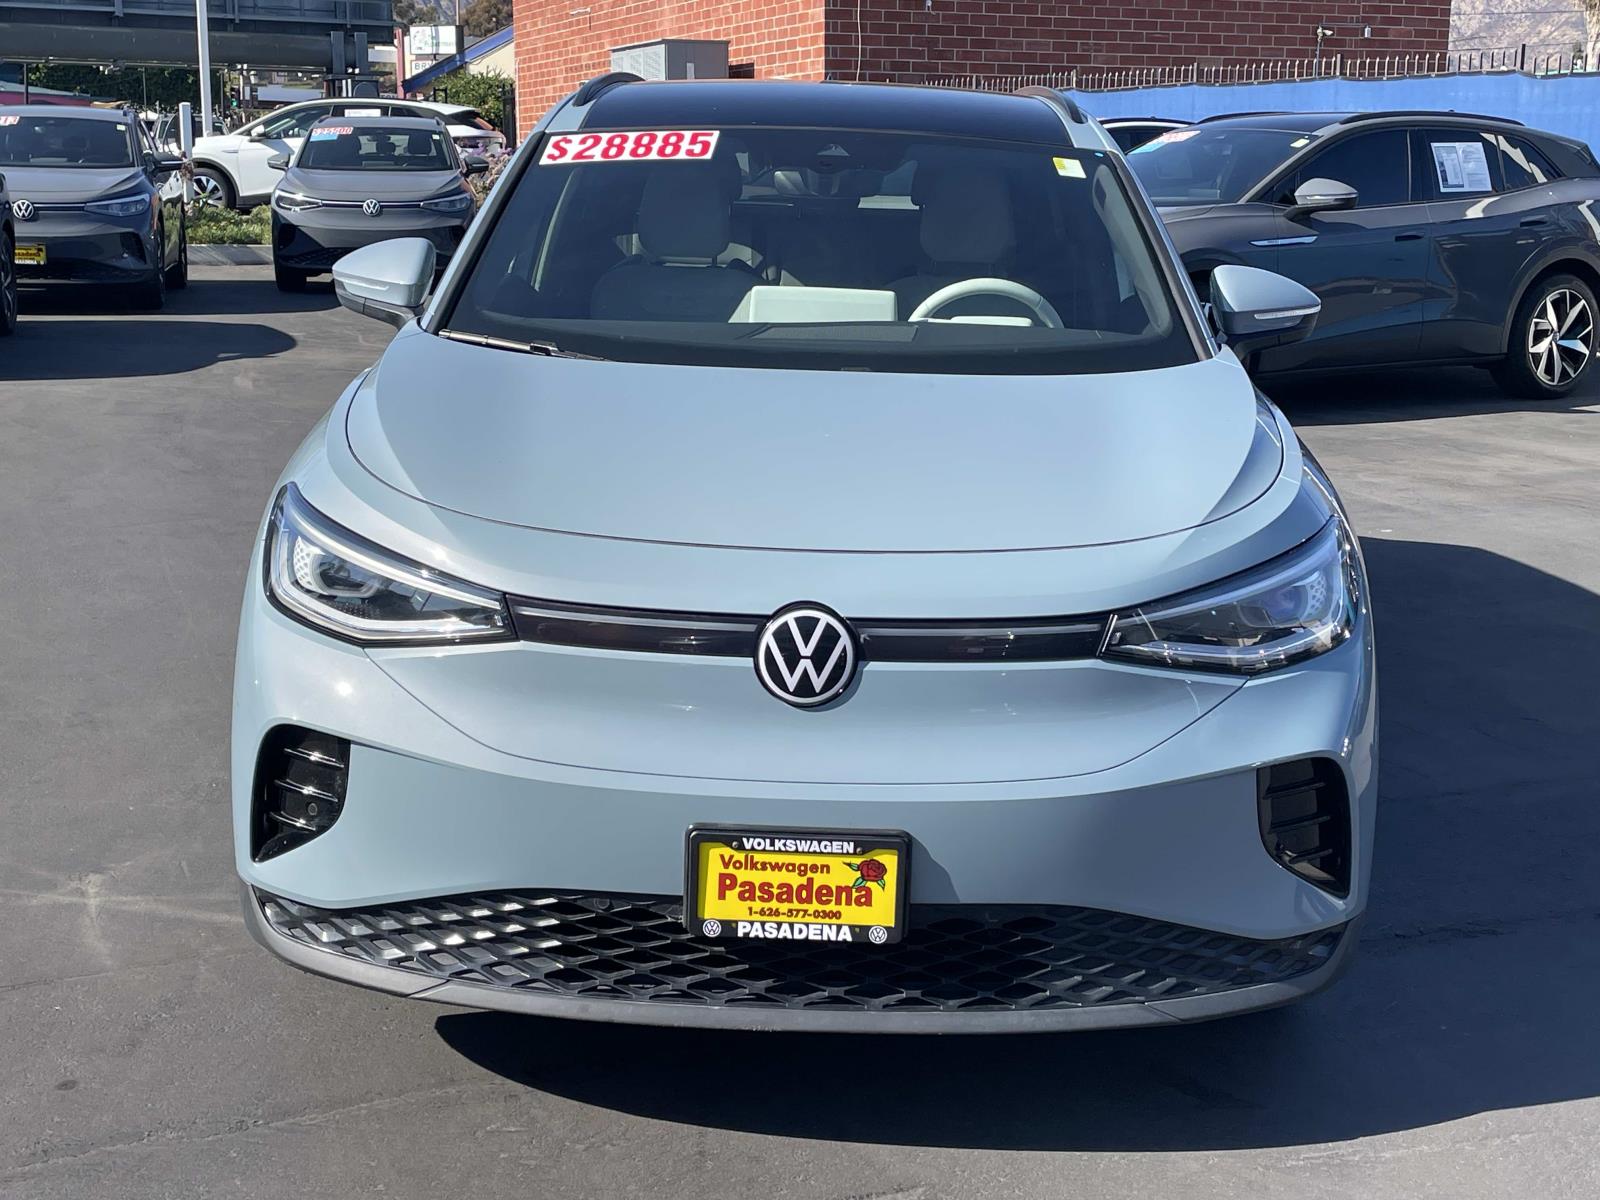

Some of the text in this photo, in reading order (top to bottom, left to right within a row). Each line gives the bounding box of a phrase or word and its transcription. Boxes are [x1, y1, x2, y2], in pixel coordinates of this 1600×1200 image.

[546, 132, 714, 161] $28885
[742, 837, 855, 854] VOLKSWAGEN
[719, 853, 831, 877] Volkswagen
[717, 872, 873, 907] Pasadena
[747, 906, 842, 920] 1-626-577-0300
[737, 921, 853, 942] PASADENA
